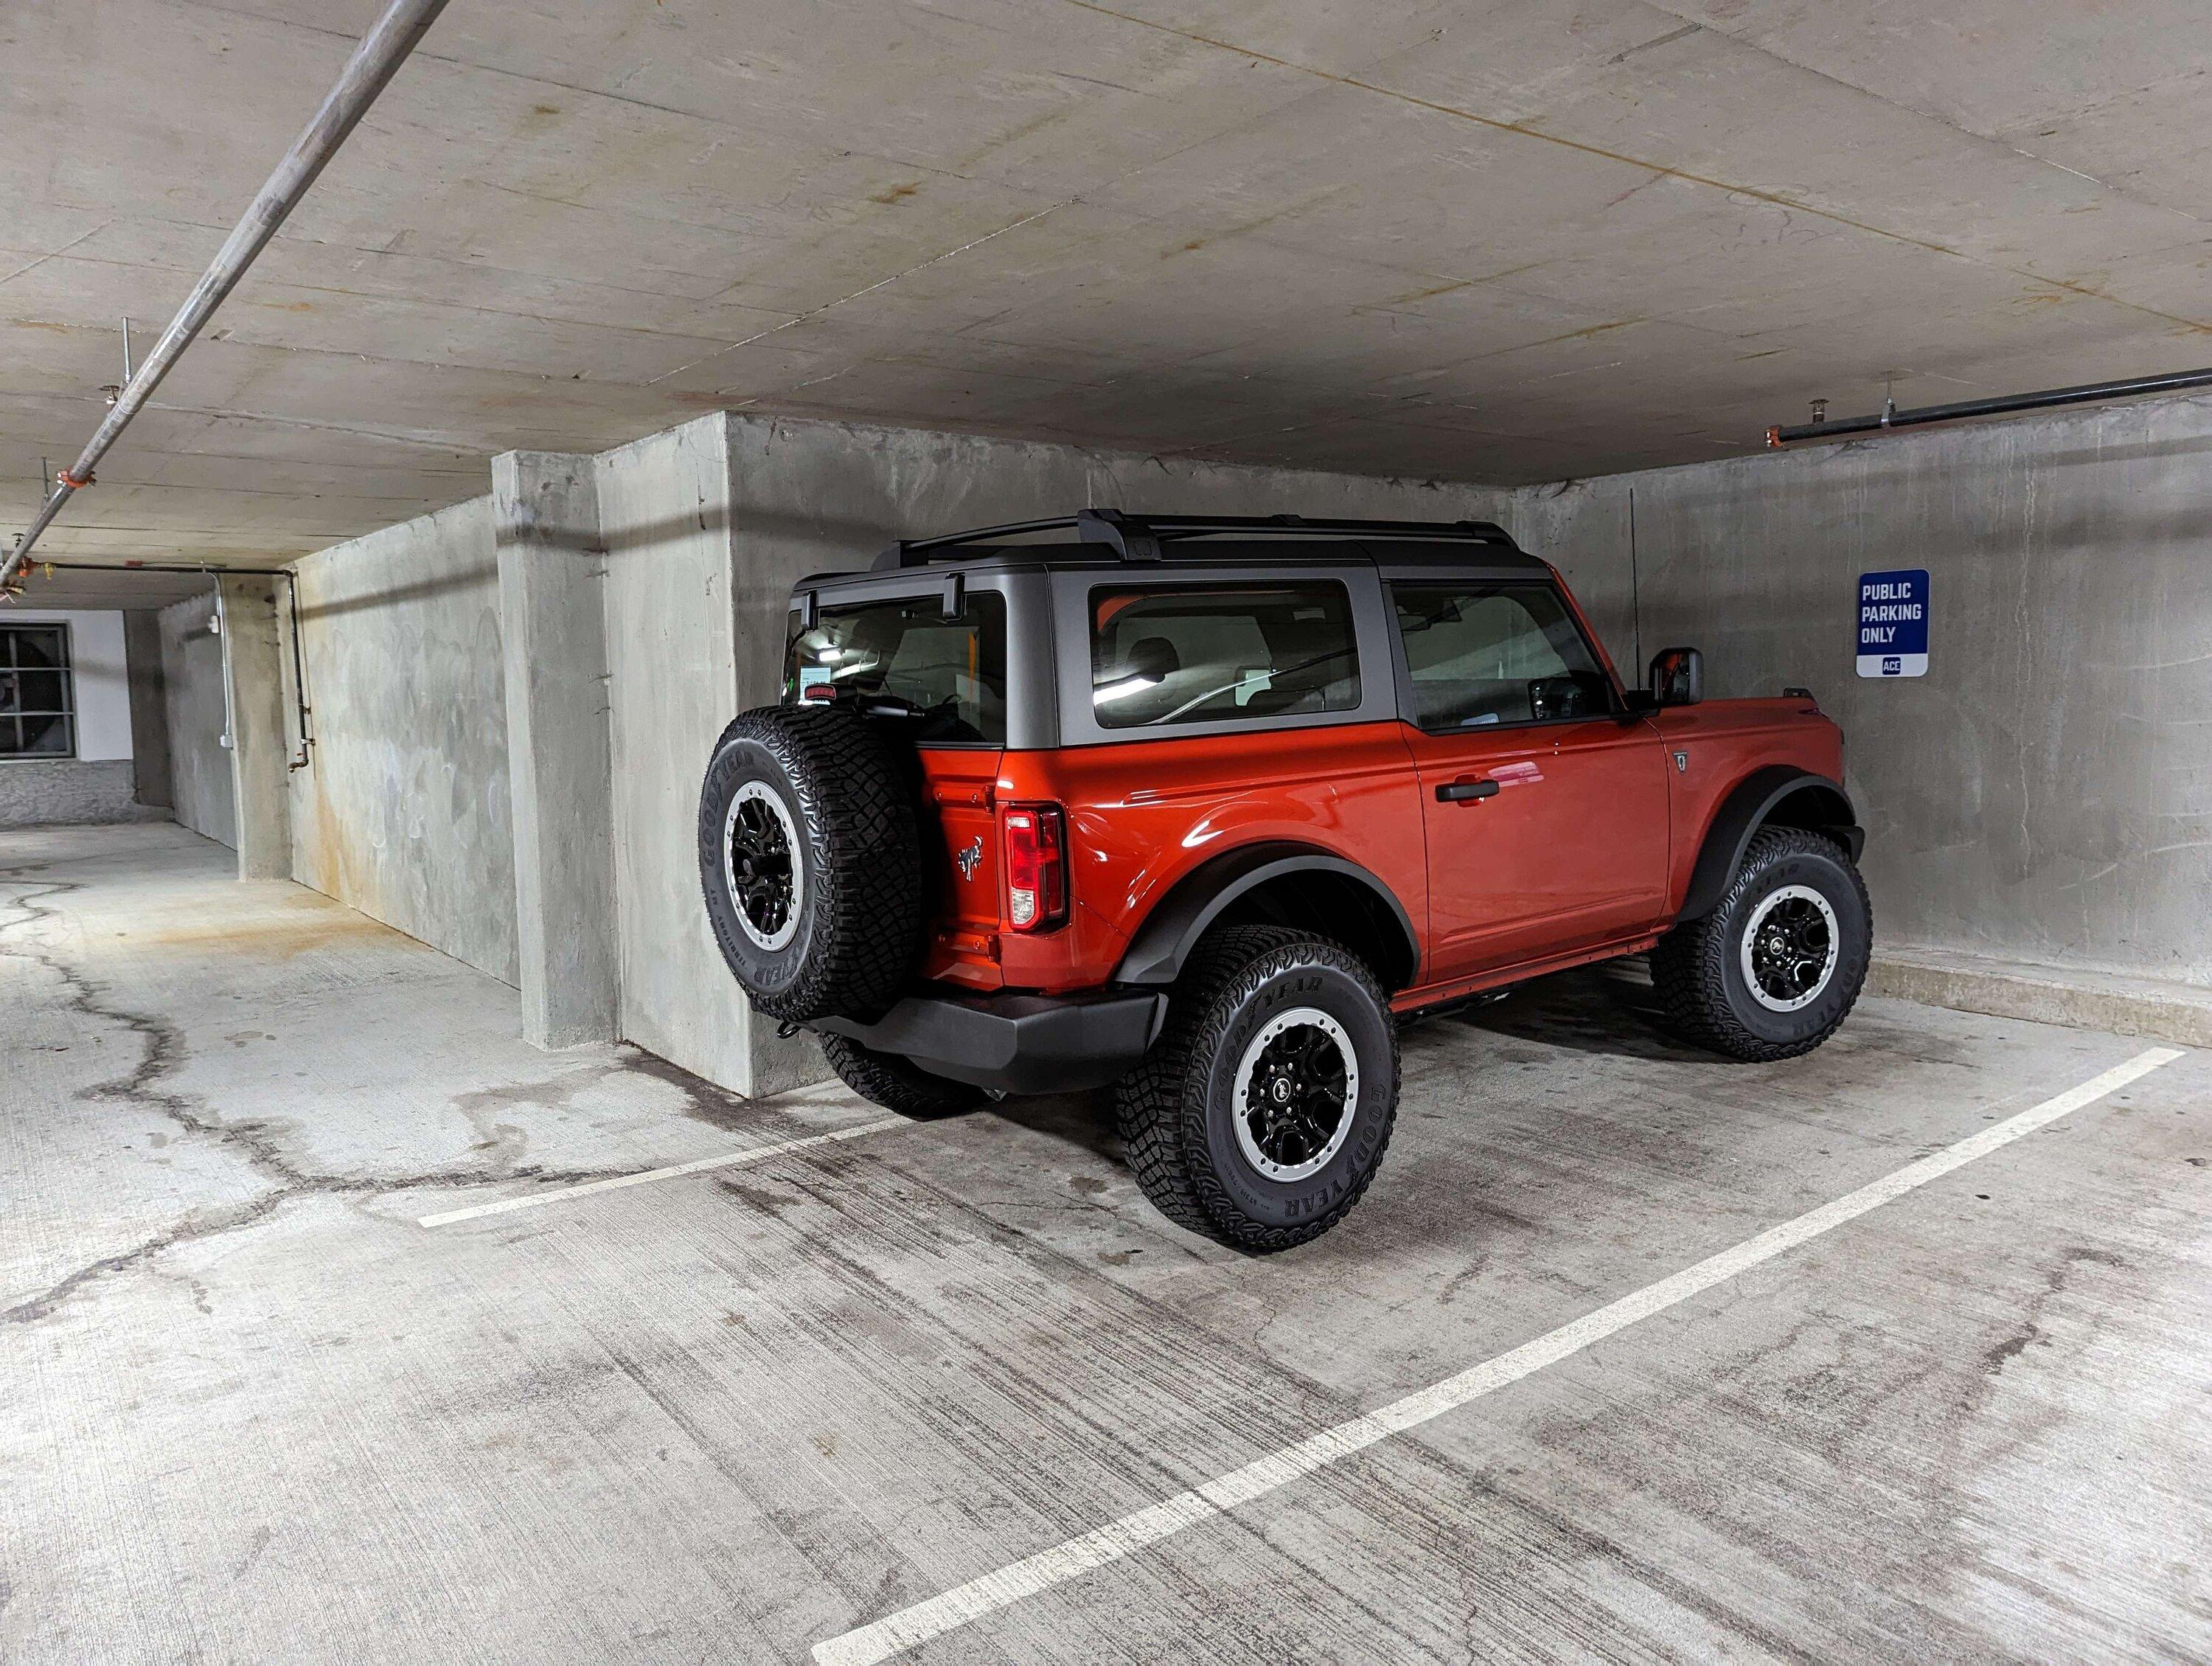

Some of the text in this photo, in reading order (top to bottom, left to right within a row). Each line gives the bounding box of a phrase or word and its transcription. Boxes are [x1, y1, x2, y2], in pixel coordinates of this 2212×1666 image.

[1863, 583, 1911, 601] PUBLIC
[1862, 604, 1921, 622] PARKING
[1861, 627, 1896, 643] ONLY
[1883, 661, 1900, 671] ACE
